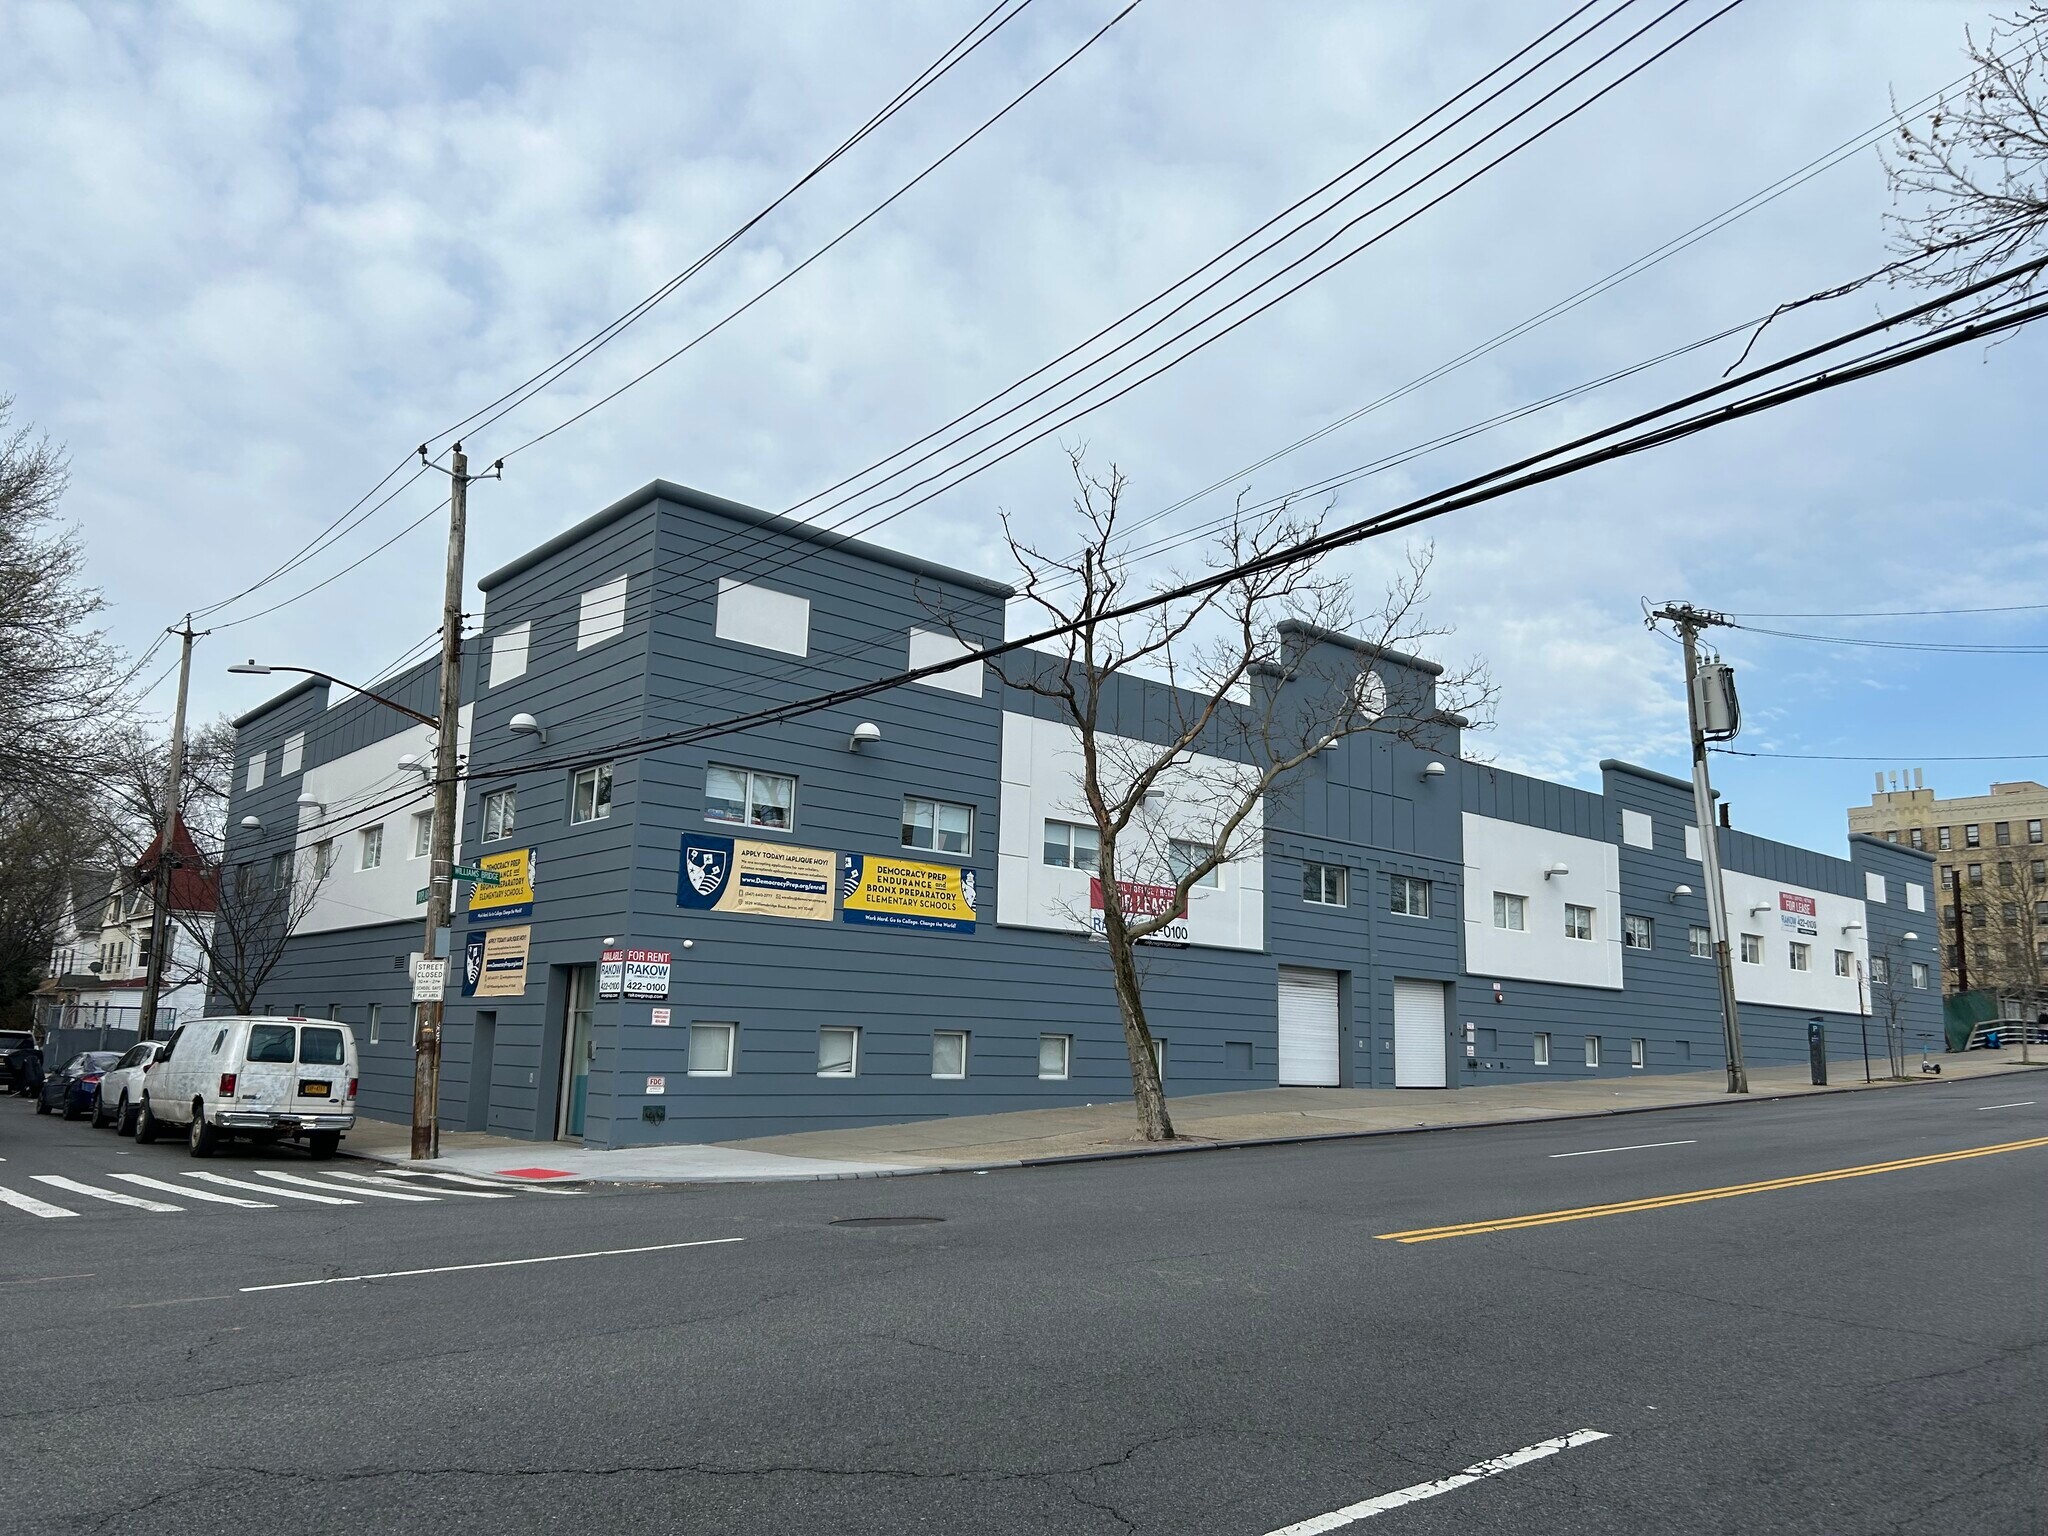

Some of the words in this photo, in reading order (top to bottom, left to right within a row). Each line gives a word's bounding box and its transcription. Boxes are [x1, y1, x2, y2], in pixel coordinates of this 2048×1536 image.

[741, 849, 761, 858] APPLY
[763, 852, 784, 860] TODAY!
[455, 867, 480, 877] WILLIAMS
[481, 871, 498, 880] BRIDGE
[877, 866, 926, 878] DEMOCRACY
[928, 871, 946, 881] PREP
[742, 878, 826, 890] www.DemocracyPrep.org/enroll
[877, 876, 932, 888] ENDURANCE
[504, 887, 523, 897] SCHOOLS
[867, 884, 897, 894] BRONX
[900, 889, 956, 900] PREPARATORY
[1160, 889, 1176, 897] RETAI
[867, 894, 918, 906] ELEMENTARY
[920, 901, 956, 910] SCHOOLS
[1796, 902, 1810, 914] LEASE
[603, 951, 623, 961] AVAILABLE
[628, 951, 645, 961] FOR
[648, 953, 669, 962] RENT
[602, 964, 621, 974] RAKOW
[627, 964, 668, 976] RAKOW
[601, 982, 619, 990] 422-0100
[627, 982, 666, 992] 422-0100
